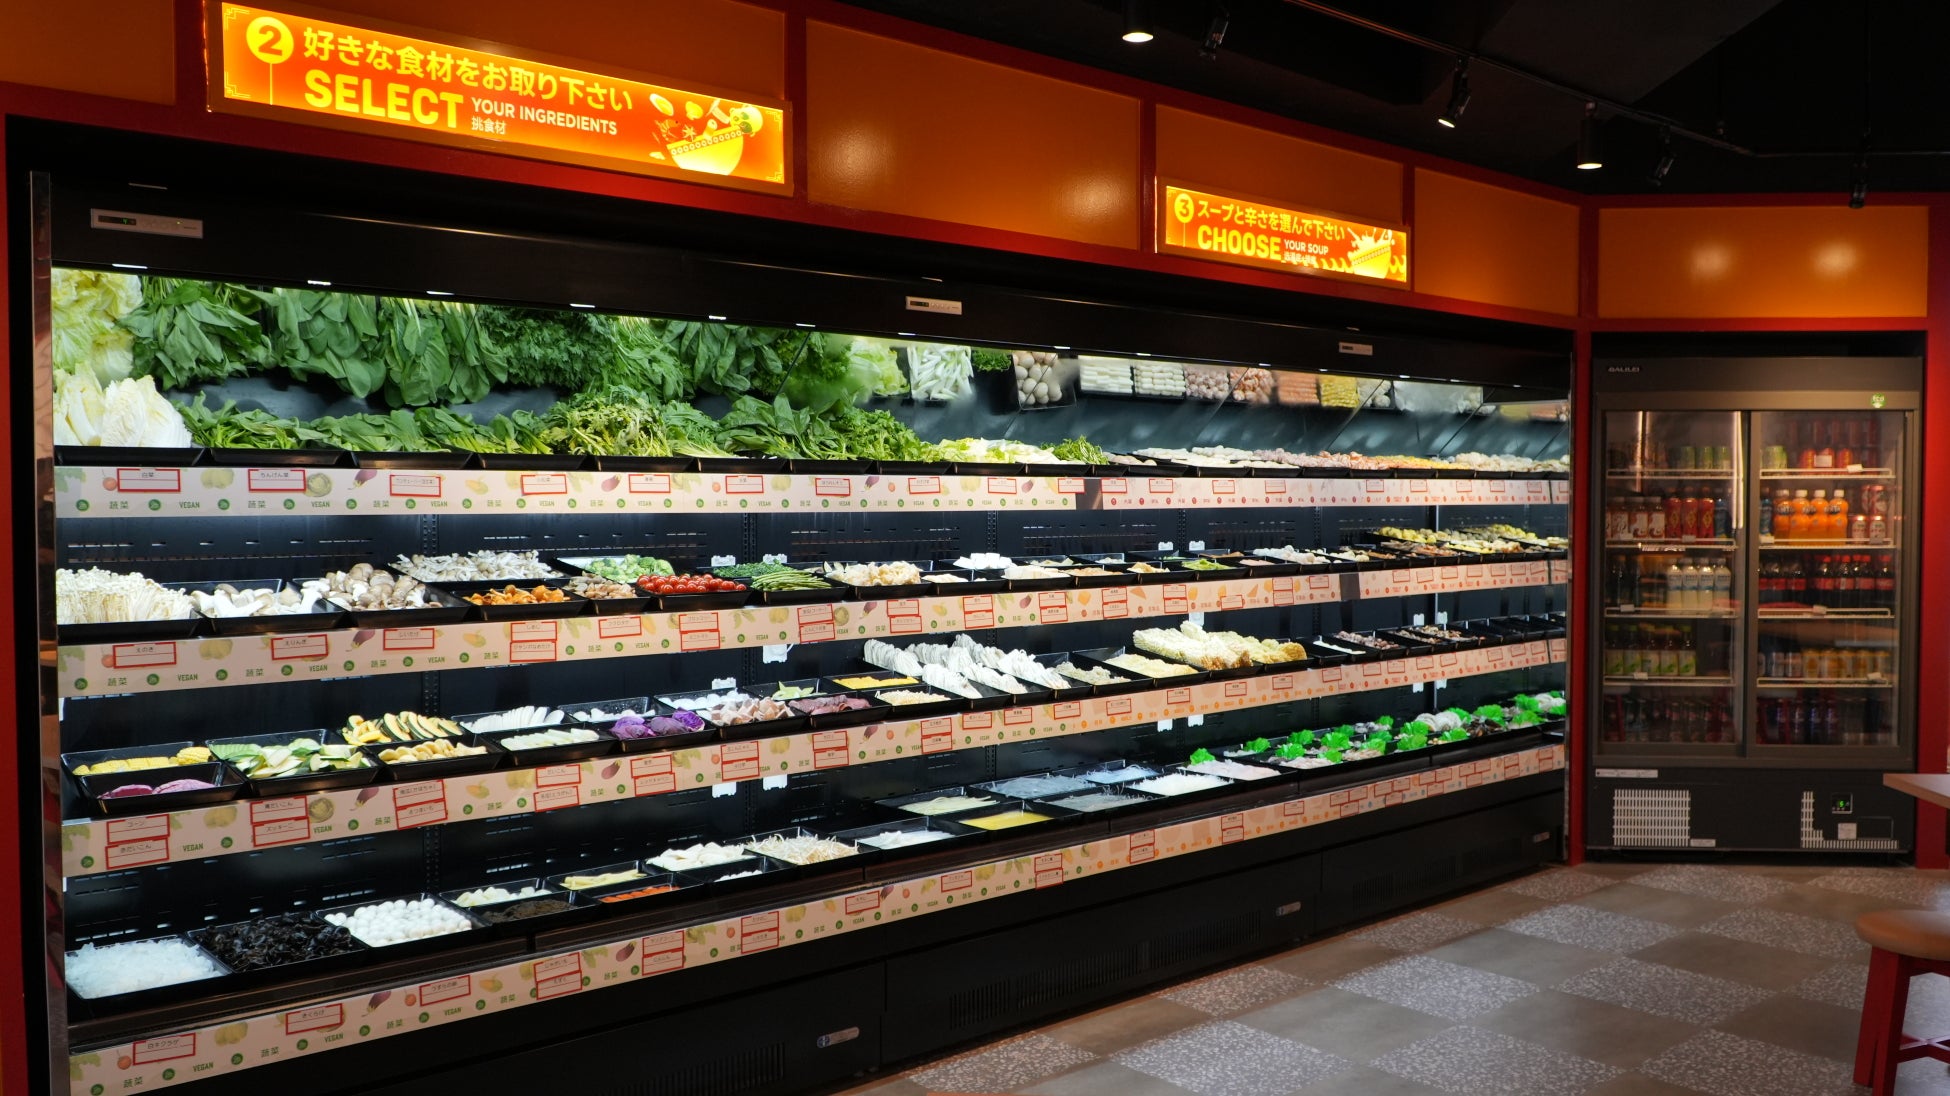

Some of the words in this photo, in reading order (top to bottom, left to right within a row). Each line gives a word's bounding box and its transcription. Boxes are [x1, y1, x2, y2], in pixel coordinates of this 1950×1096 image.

[258, 25, 283, 56] 2
[304, 27, 632, 111] 好きな食材をお取り下さい
[305, 69, 463, 128] SELECT
[472, 97, 515, 118] YOUR
[520, 105, 617, 135] INGREDIENTS
[471, 116, 506, 135] 挑食材
[1179, 198, 1189, 216] 3
[1197, 200, 1345, 241] スープと辛さを選んで下さい
[1197, 225, 1282, 260] CHOOSE
[1284, 239, 1306, 252] YOUR
[1308, 243, 1329, 255] SOUP
[178, 501, 200, 509] VEGAN
[428, 656, 445, 664] VEGAN
[309, 665, 328, 673] VEGAN
[177, 673, 199, 682] VEGAN
[314, 825, 332, 834] VEGAN
[183, 843, 204, 852] VEGAN
[302, 1010, 324, 1019] きくらげ
[443, 1007, 462, 1016] VEGAN
[324, 1033, 344, 1043] VEGAN
[147, 1039, 179, 1049] 白キクラゲ
[193, 1061, 214, 1072] VEGAN
